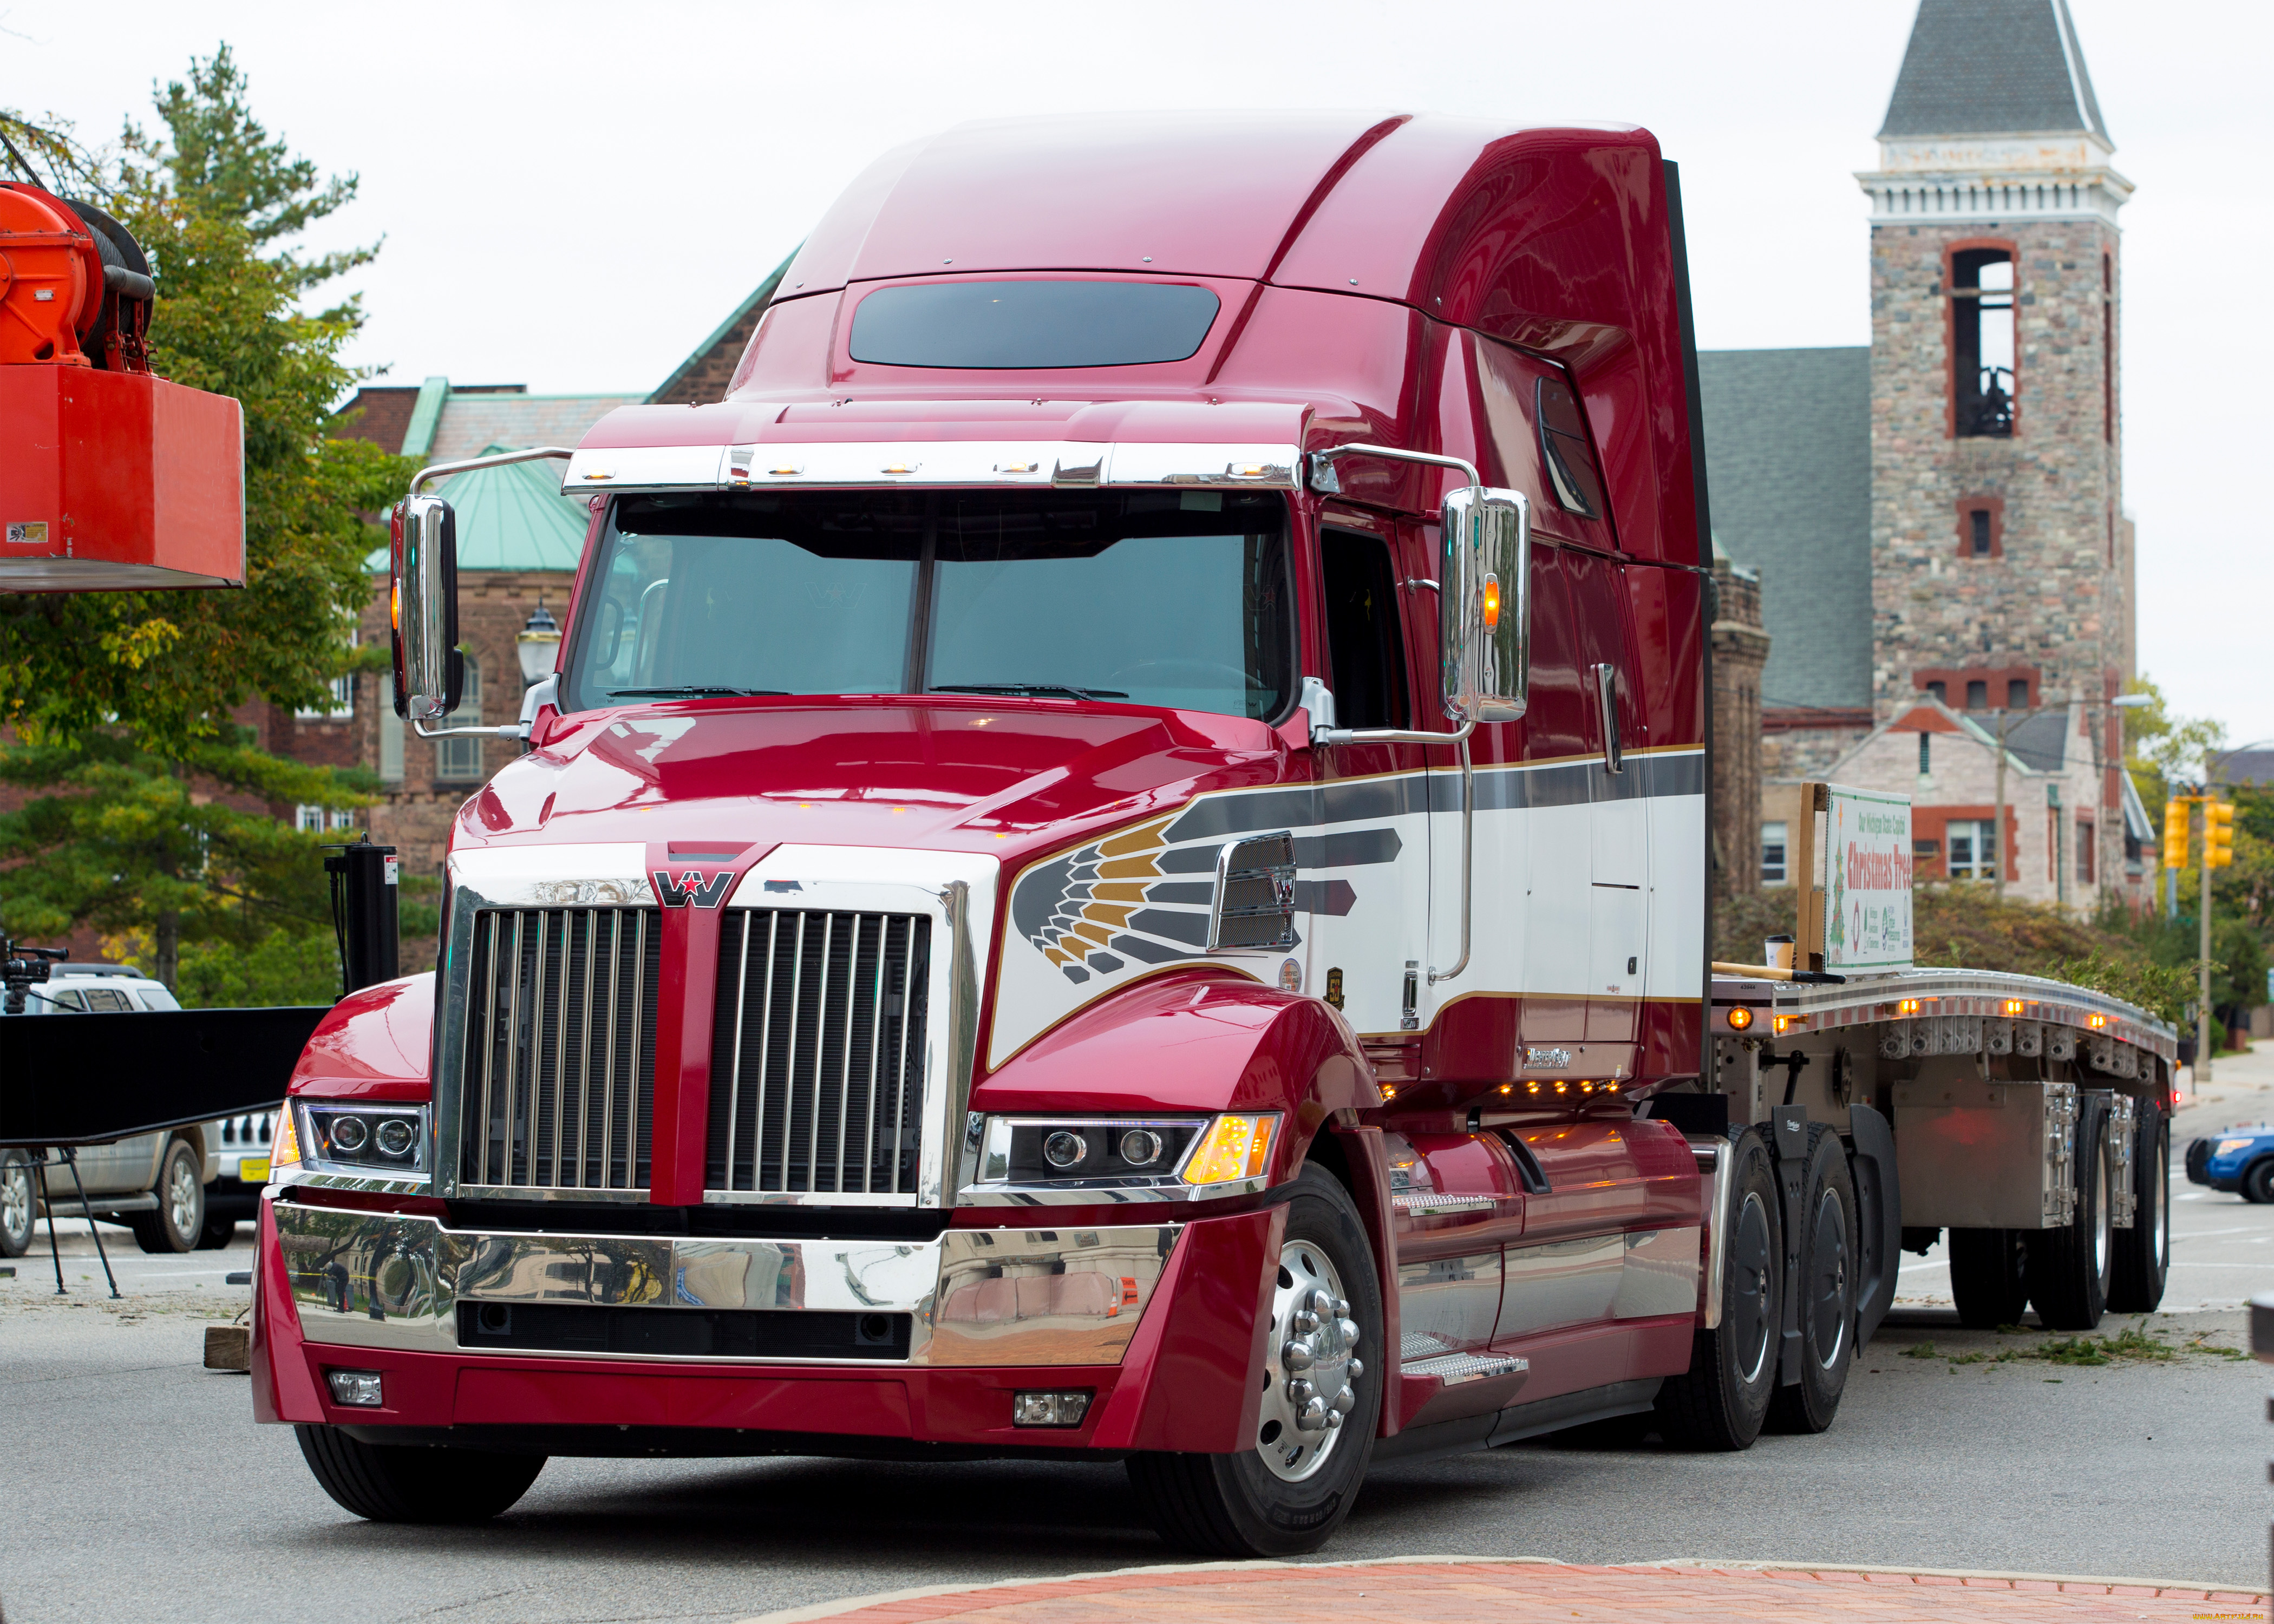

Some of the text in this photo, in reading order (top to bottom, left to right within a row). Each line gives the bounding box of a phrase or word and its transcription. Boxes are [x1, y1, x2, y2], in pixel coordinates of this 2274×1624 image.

[1866, 812, 1882, 840] Michigan
[1883, 813, 1892, 834] State
[1848, 841, 1911, 890] Christmas Tree
